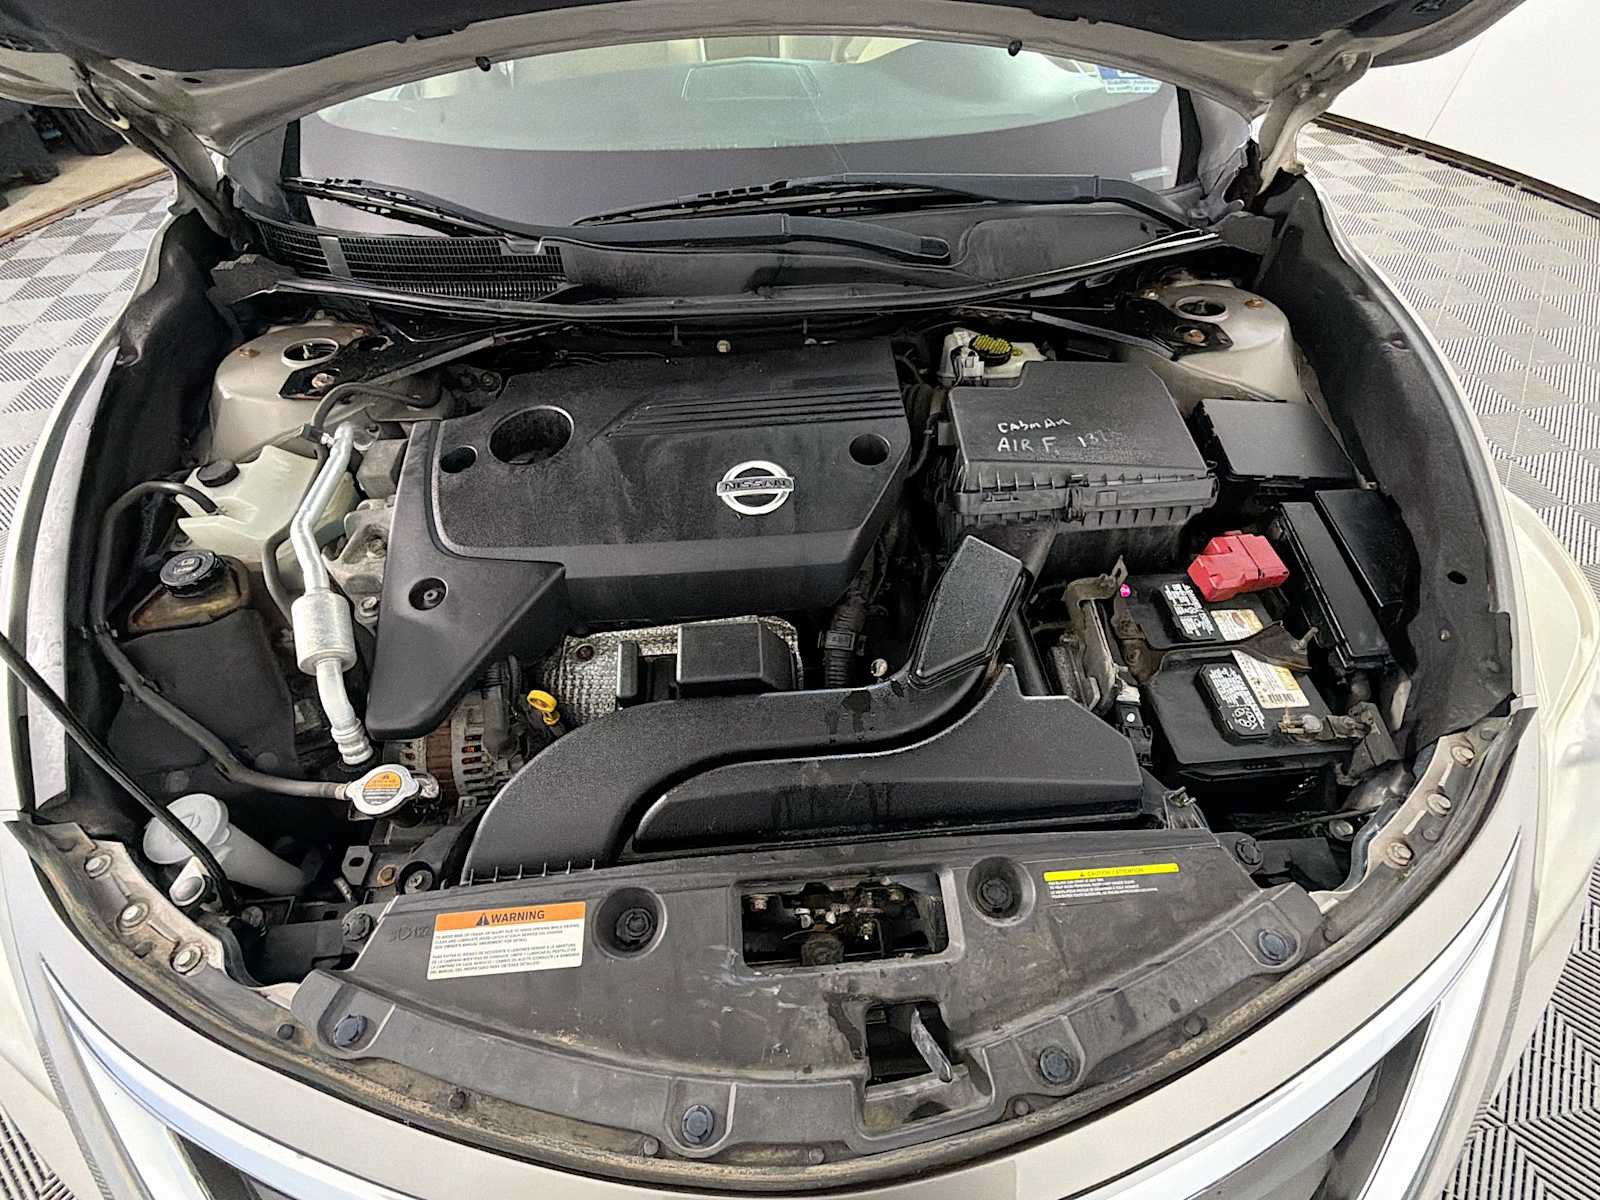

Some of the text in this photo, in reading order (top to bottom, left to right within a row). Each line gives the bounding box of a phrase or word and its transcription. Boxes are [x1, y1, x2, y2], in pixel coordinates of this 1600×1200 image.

[997, 436, 1034, 453] AIR
[724, 480, 786, 491] NISSAN
[491, 910, 545, 923] WARNING
